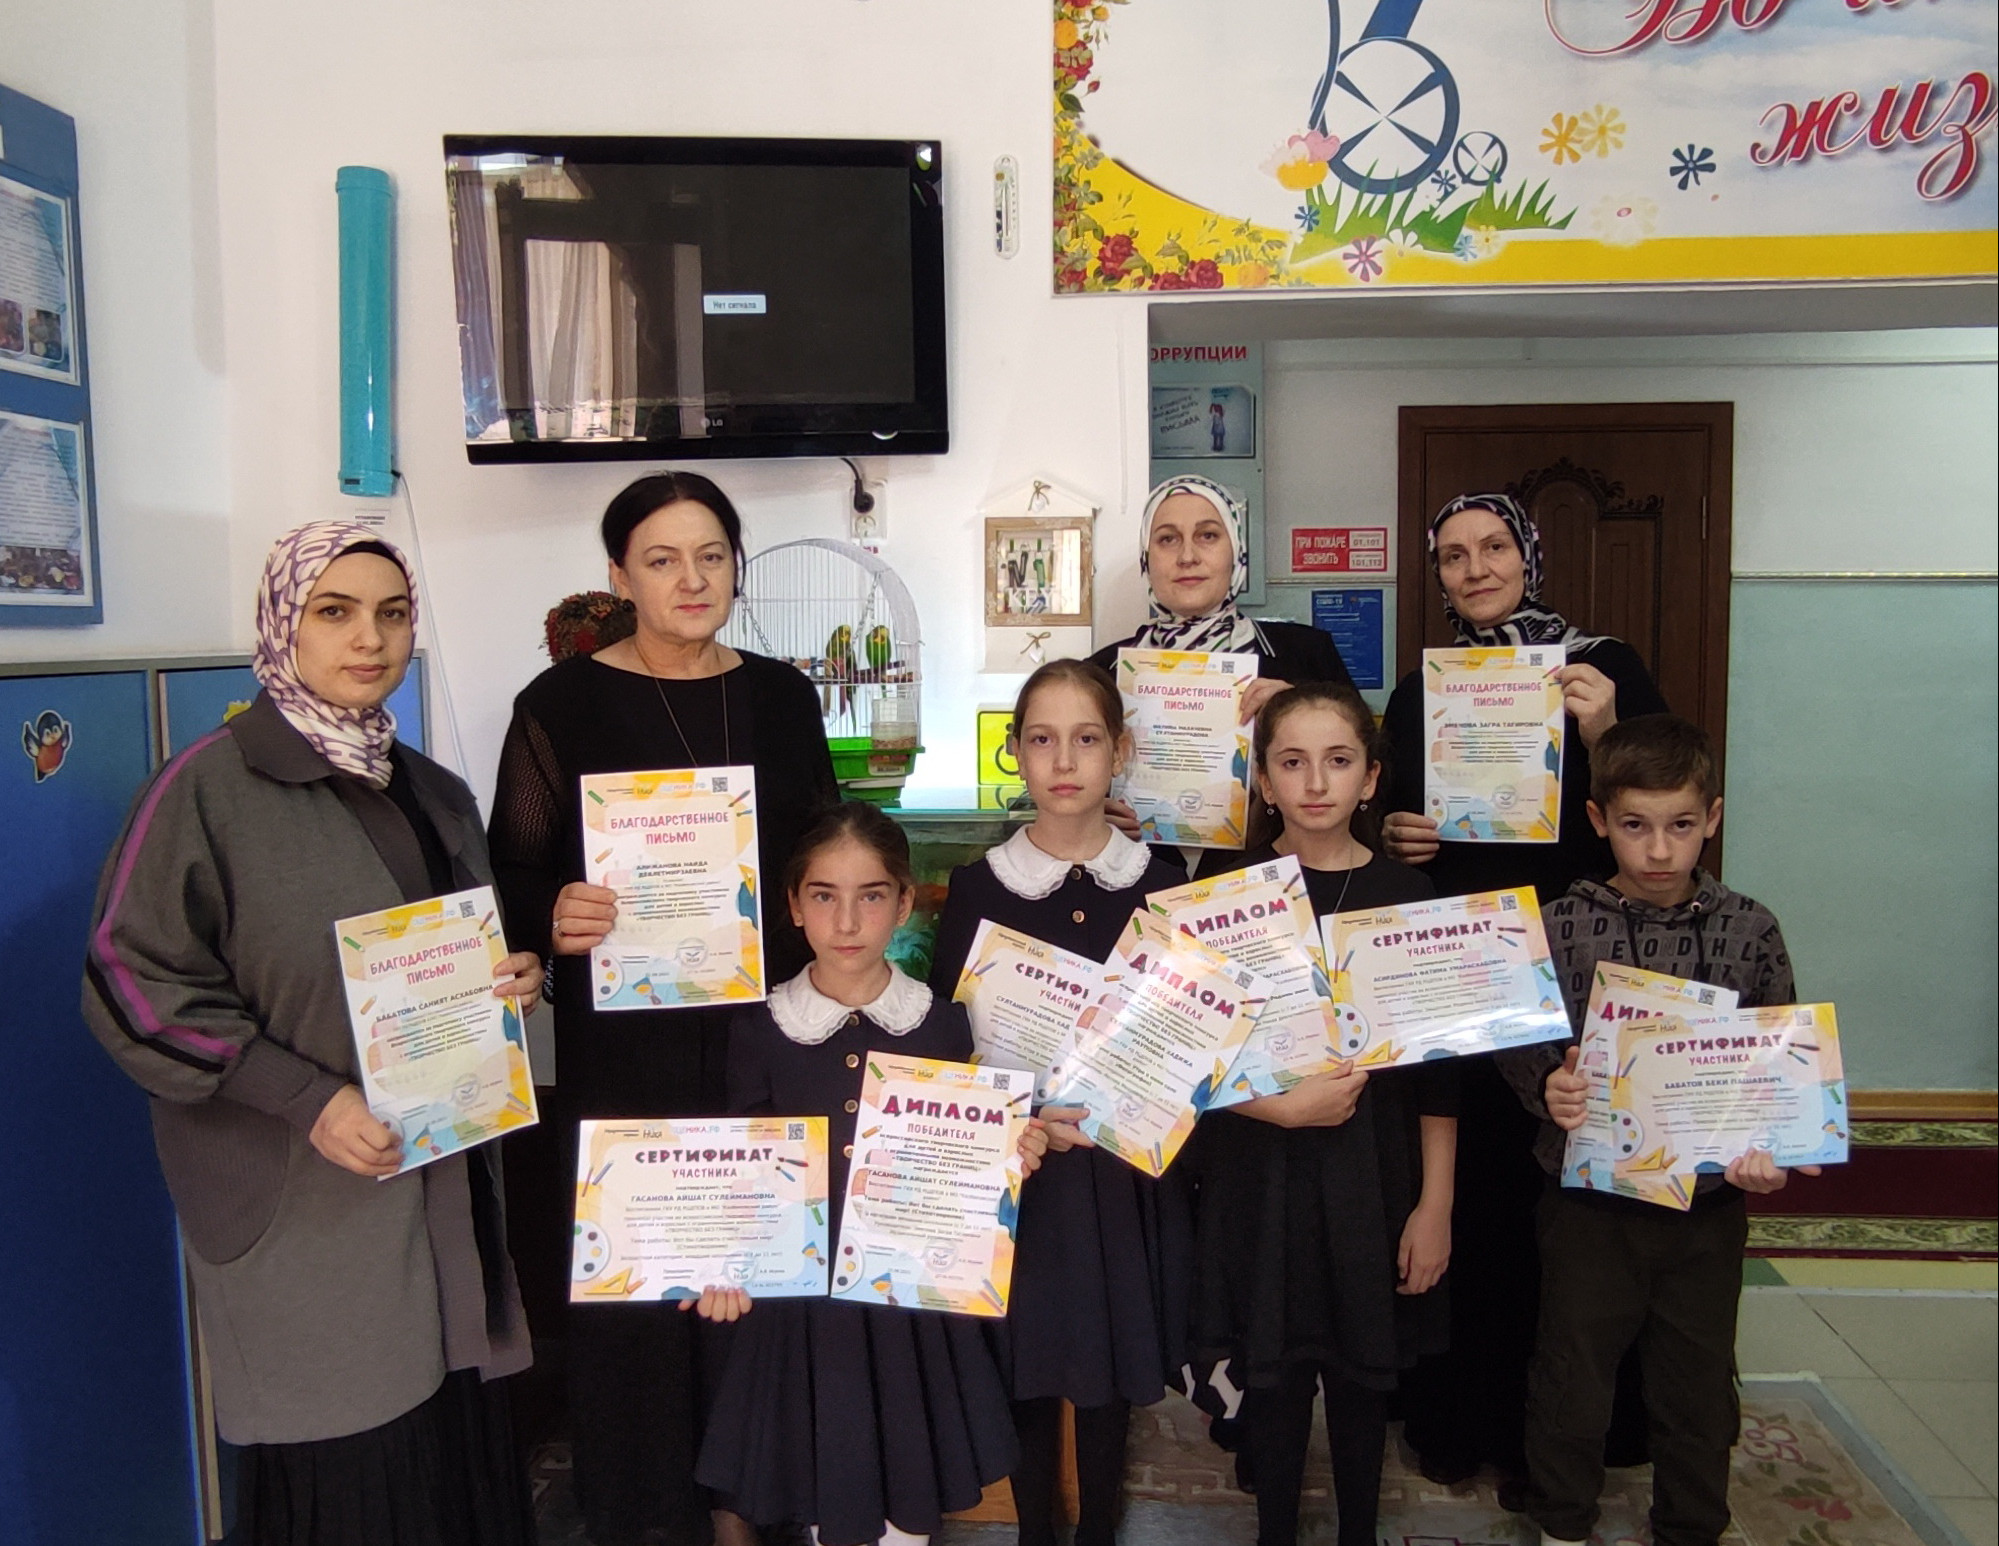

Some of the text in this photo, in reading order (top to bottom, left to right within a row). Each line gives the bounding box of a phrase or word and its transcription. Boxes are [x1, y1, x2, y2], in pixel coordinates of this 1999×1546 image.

[712, 300, 757, 310] Нет сигнала
[711, 418, 724, 427] LG
[1295, 536, 1312, 549] ПРИ
[1303, 552, 1339, 565] ЗВОНИТЬ
[1137, 684, 1233, 699] БЛАГОДАРСТВЕННОЕ
[1446, 681, 1543, 694] БЛАГОДАРСТВЕННОЕ
[1163, 700, 1205, 711] ПИСЬМО
[1473, 697, 1515, 707] ПИСЬМО
[610, 811, 729, 830] БЛАГОДАРСТВЕННОЕ
[645, 831, 697, 845] ПИСЬМО
[1205, 926, 1269, 949] ПОБЕДИТЕЛЯ
[1372, 920, 1493, 948] СЕРТИФИКАТ
[370, 936, 483, 976] БЛАГОДАРСТВЕННОЕ
[1406, 942, 1466, 958] УЧАСТНИКА
[406, 962, 456, 986] ПИСЬМО
[1129, 952, 1236, 1019] ДИПЛОМ
[376, 1006, 418, 1022] БАБАТОВА
[450, 984, 494, 1001] АСХАБОВНА
[1146, 984, 1204, 1022] ПОБЕДИТЕЛЯ
[1655, 1033, 1783, 1056] СЕРТИФИКАТ
[1688, 1053, 1751, 1067] УЧАСТНИКА
[1664, 1076, 1782, 1089] БАБАТОВ БЕКИ ПАШАЕВИЧ
[882, 1095, 1005, 1126] ДИПЛОМ
[907, 1123, 976, 1141] ПОБЕДИТЕЛЯ
[635, 1148, 773, 1164] СЕРТИФИКАТ
[672, 1168, 738, 1179] УЧАСТНИКА
[868, 1170, 908, 1180] ГАСАНОВА
